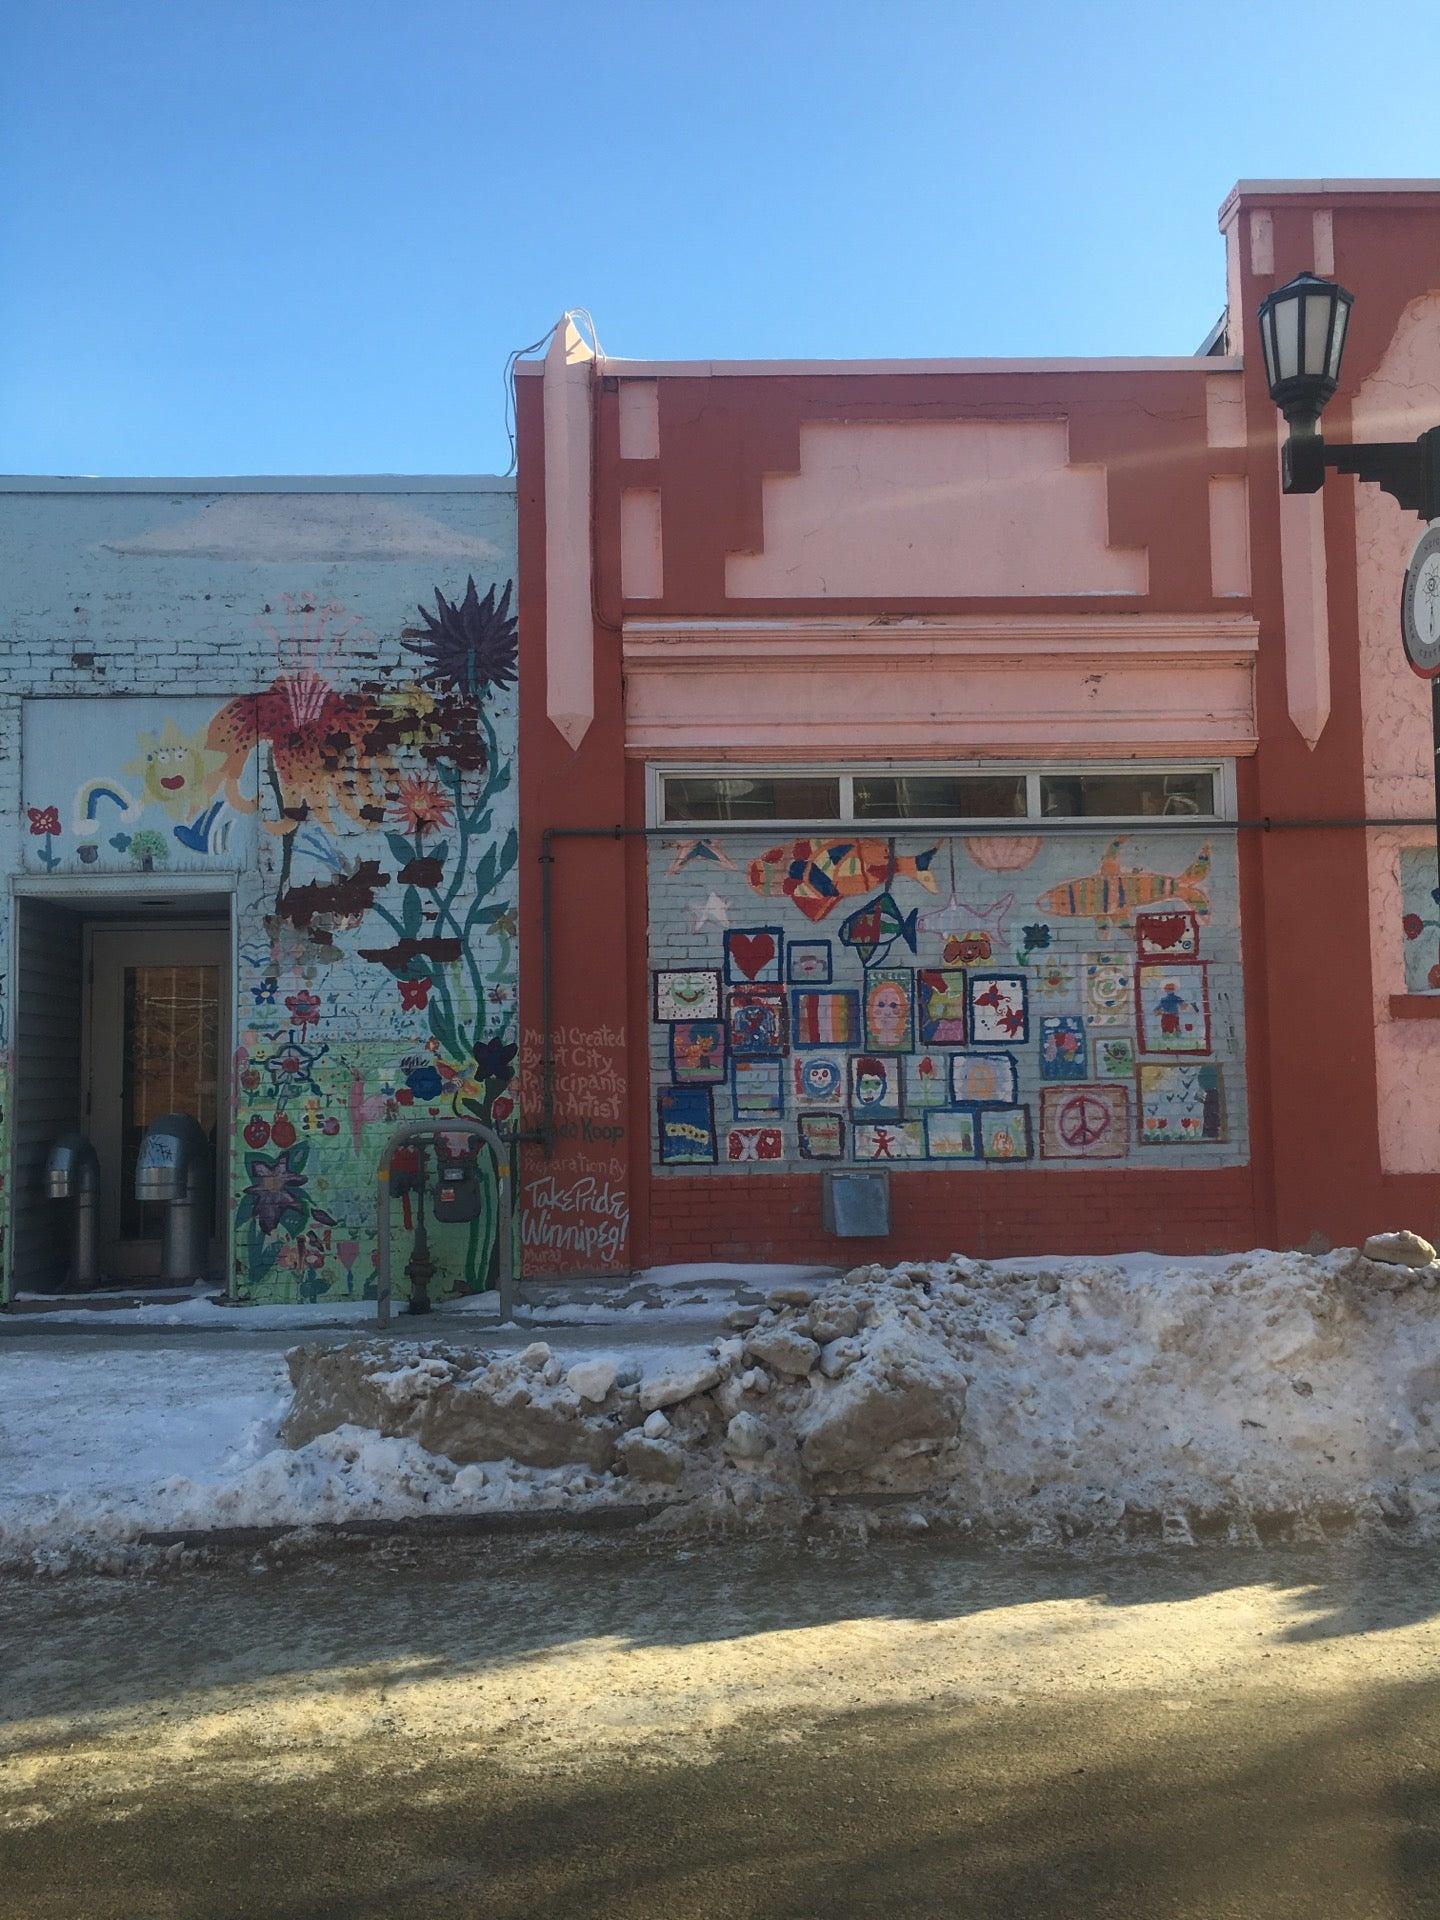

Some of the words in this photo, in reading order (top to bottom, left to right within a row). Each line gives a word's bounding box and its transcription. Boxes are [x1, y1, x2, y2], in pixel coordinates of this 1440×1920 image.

[523, 1026, 565, 1046] Mual
[569, 1024, 625, 1047] Created
[521, 1047, 542, 1069] By
[549, 1046, 569, 1067] rt
[572, 1047, 612, 1075] City
[520, 1091, 564, 1116] Wih
[566, 1091, 622, 1120] Artist
[608, 1158, 626, 1182] By
[524, 1176, 575, 1212] Take
[570, 1177, 629, 1219] Pride
[521, 1209, 629, 1262] Winnipeg!
